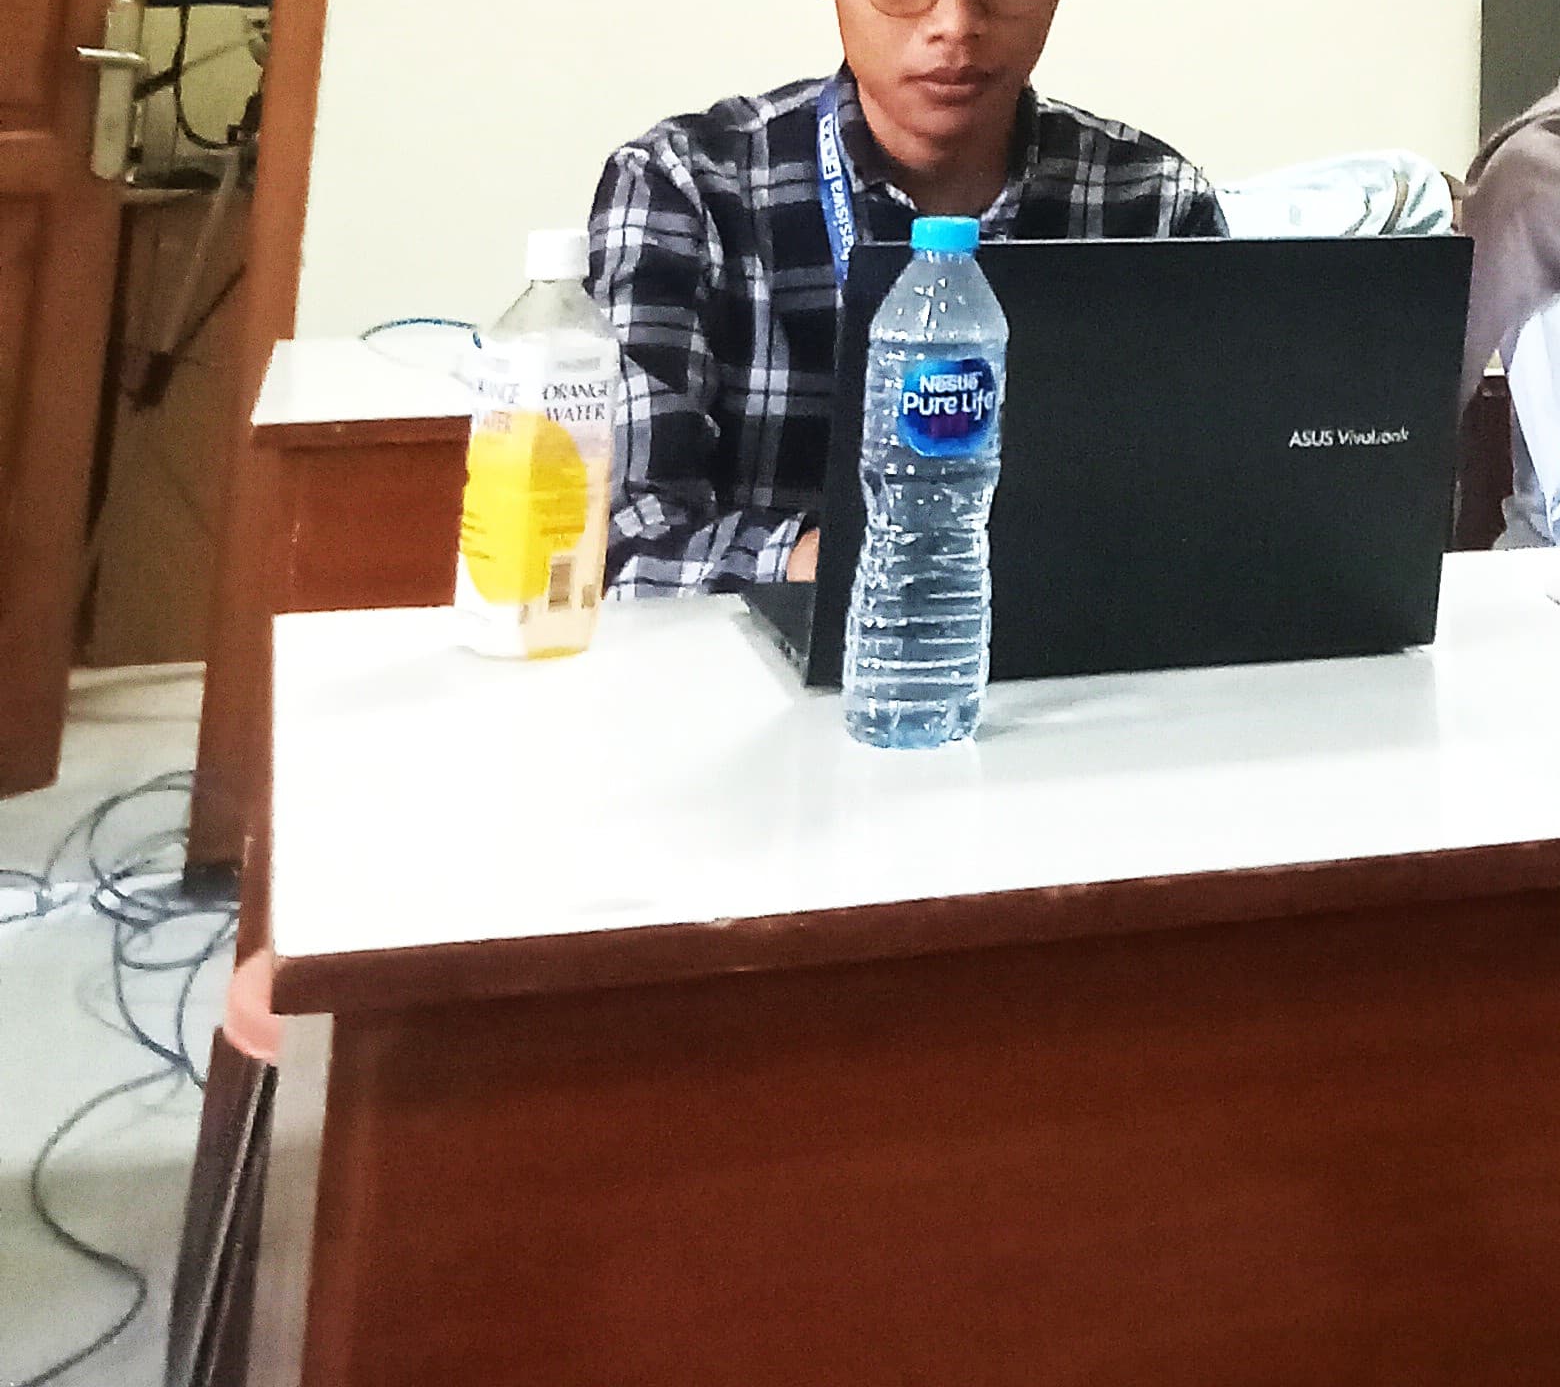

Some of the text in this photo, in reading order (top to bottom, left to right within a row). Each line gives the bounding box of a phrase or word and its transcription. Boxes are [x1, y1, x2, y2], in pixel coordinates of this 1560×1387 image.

[902, 388, 996, 421] Pure Life
[1288, 424, 1410, 448] ASUS Vivobook
